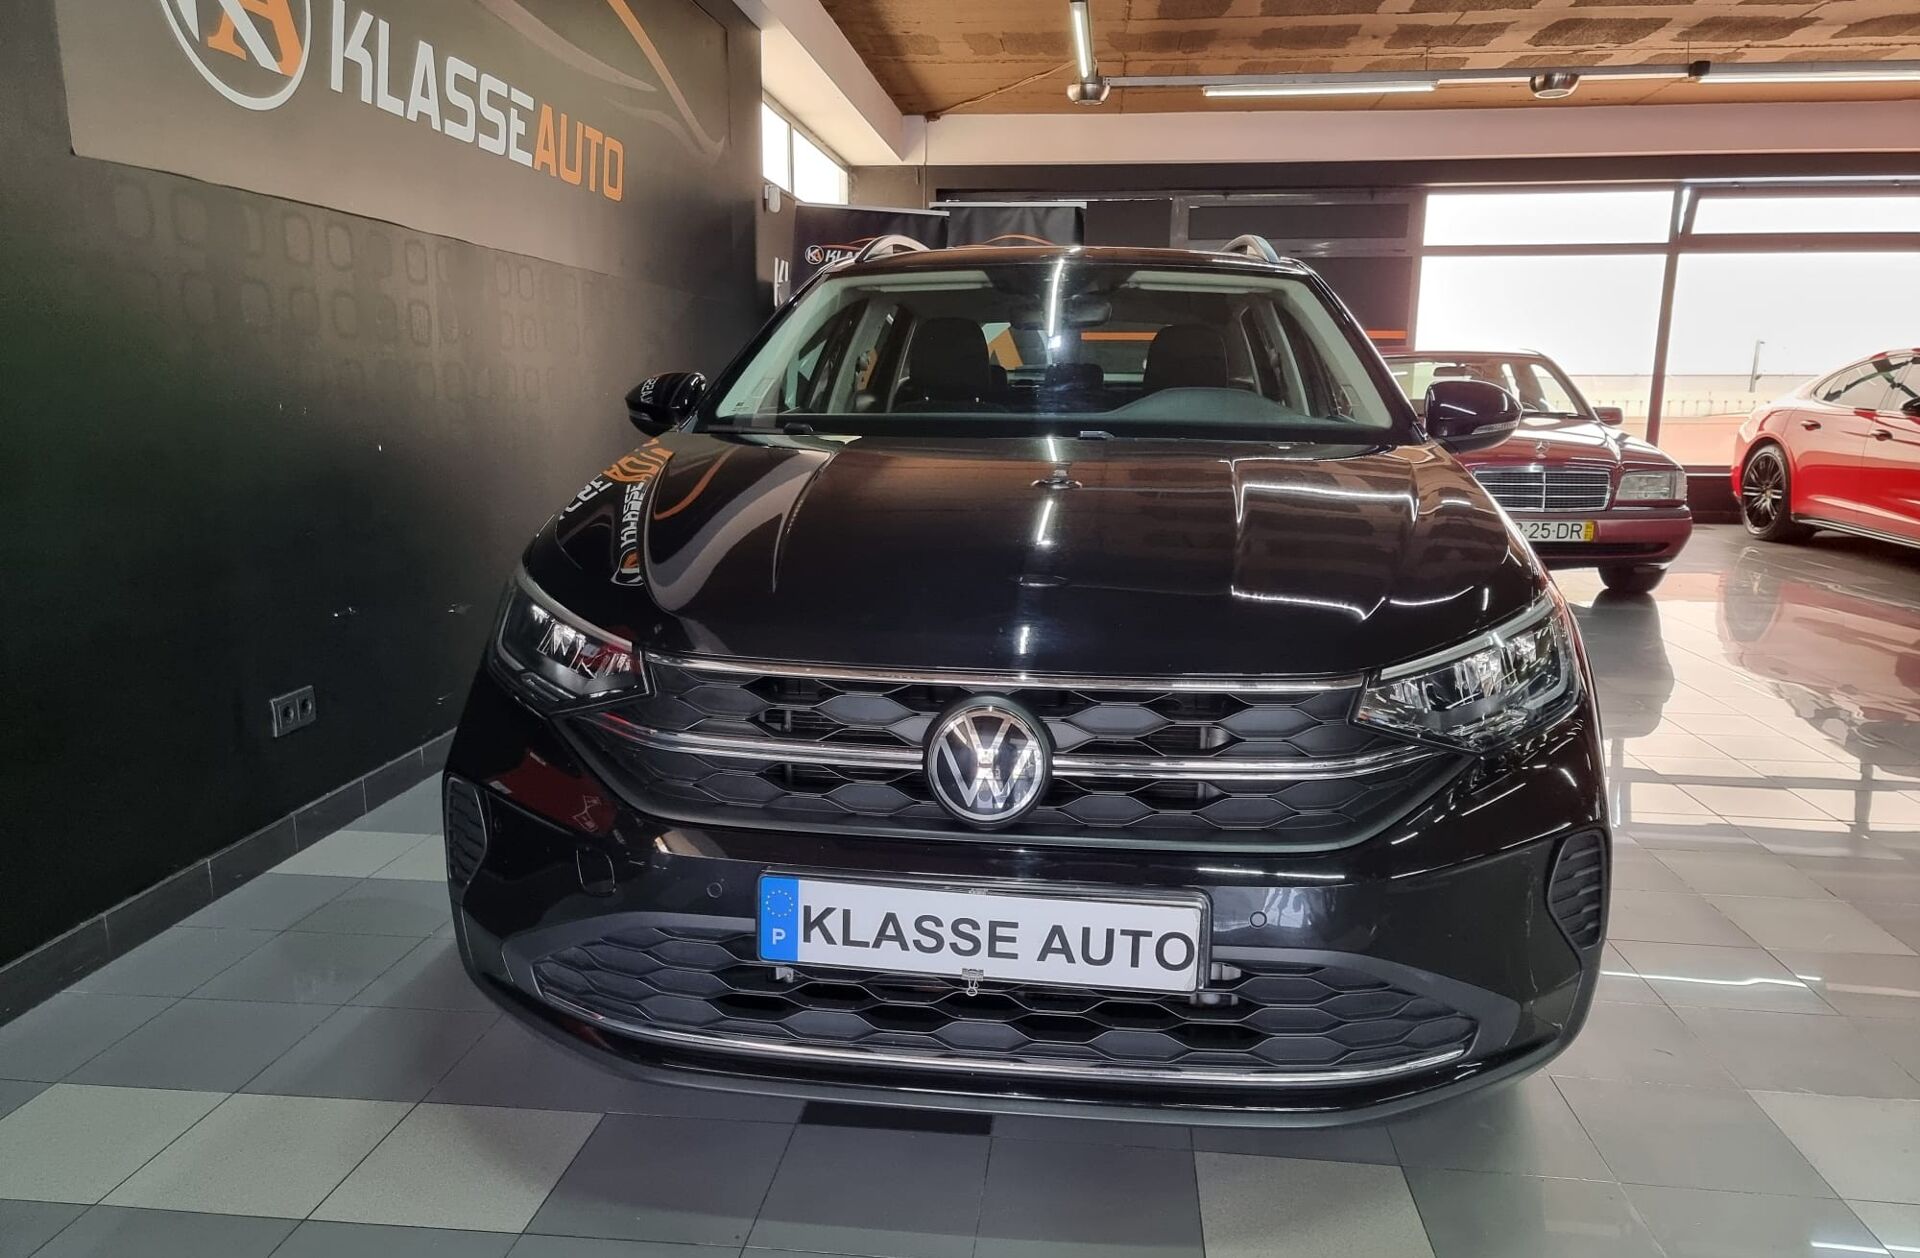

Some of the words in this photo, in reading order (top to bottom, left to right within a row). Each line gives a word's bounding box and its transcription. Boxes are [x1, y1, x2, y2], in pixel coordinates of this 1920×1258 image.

[772, 928, 786, 945] P
[802, 904, 1019, 960] KLASSE
[1036, 924, 1196, 972] AUTO
